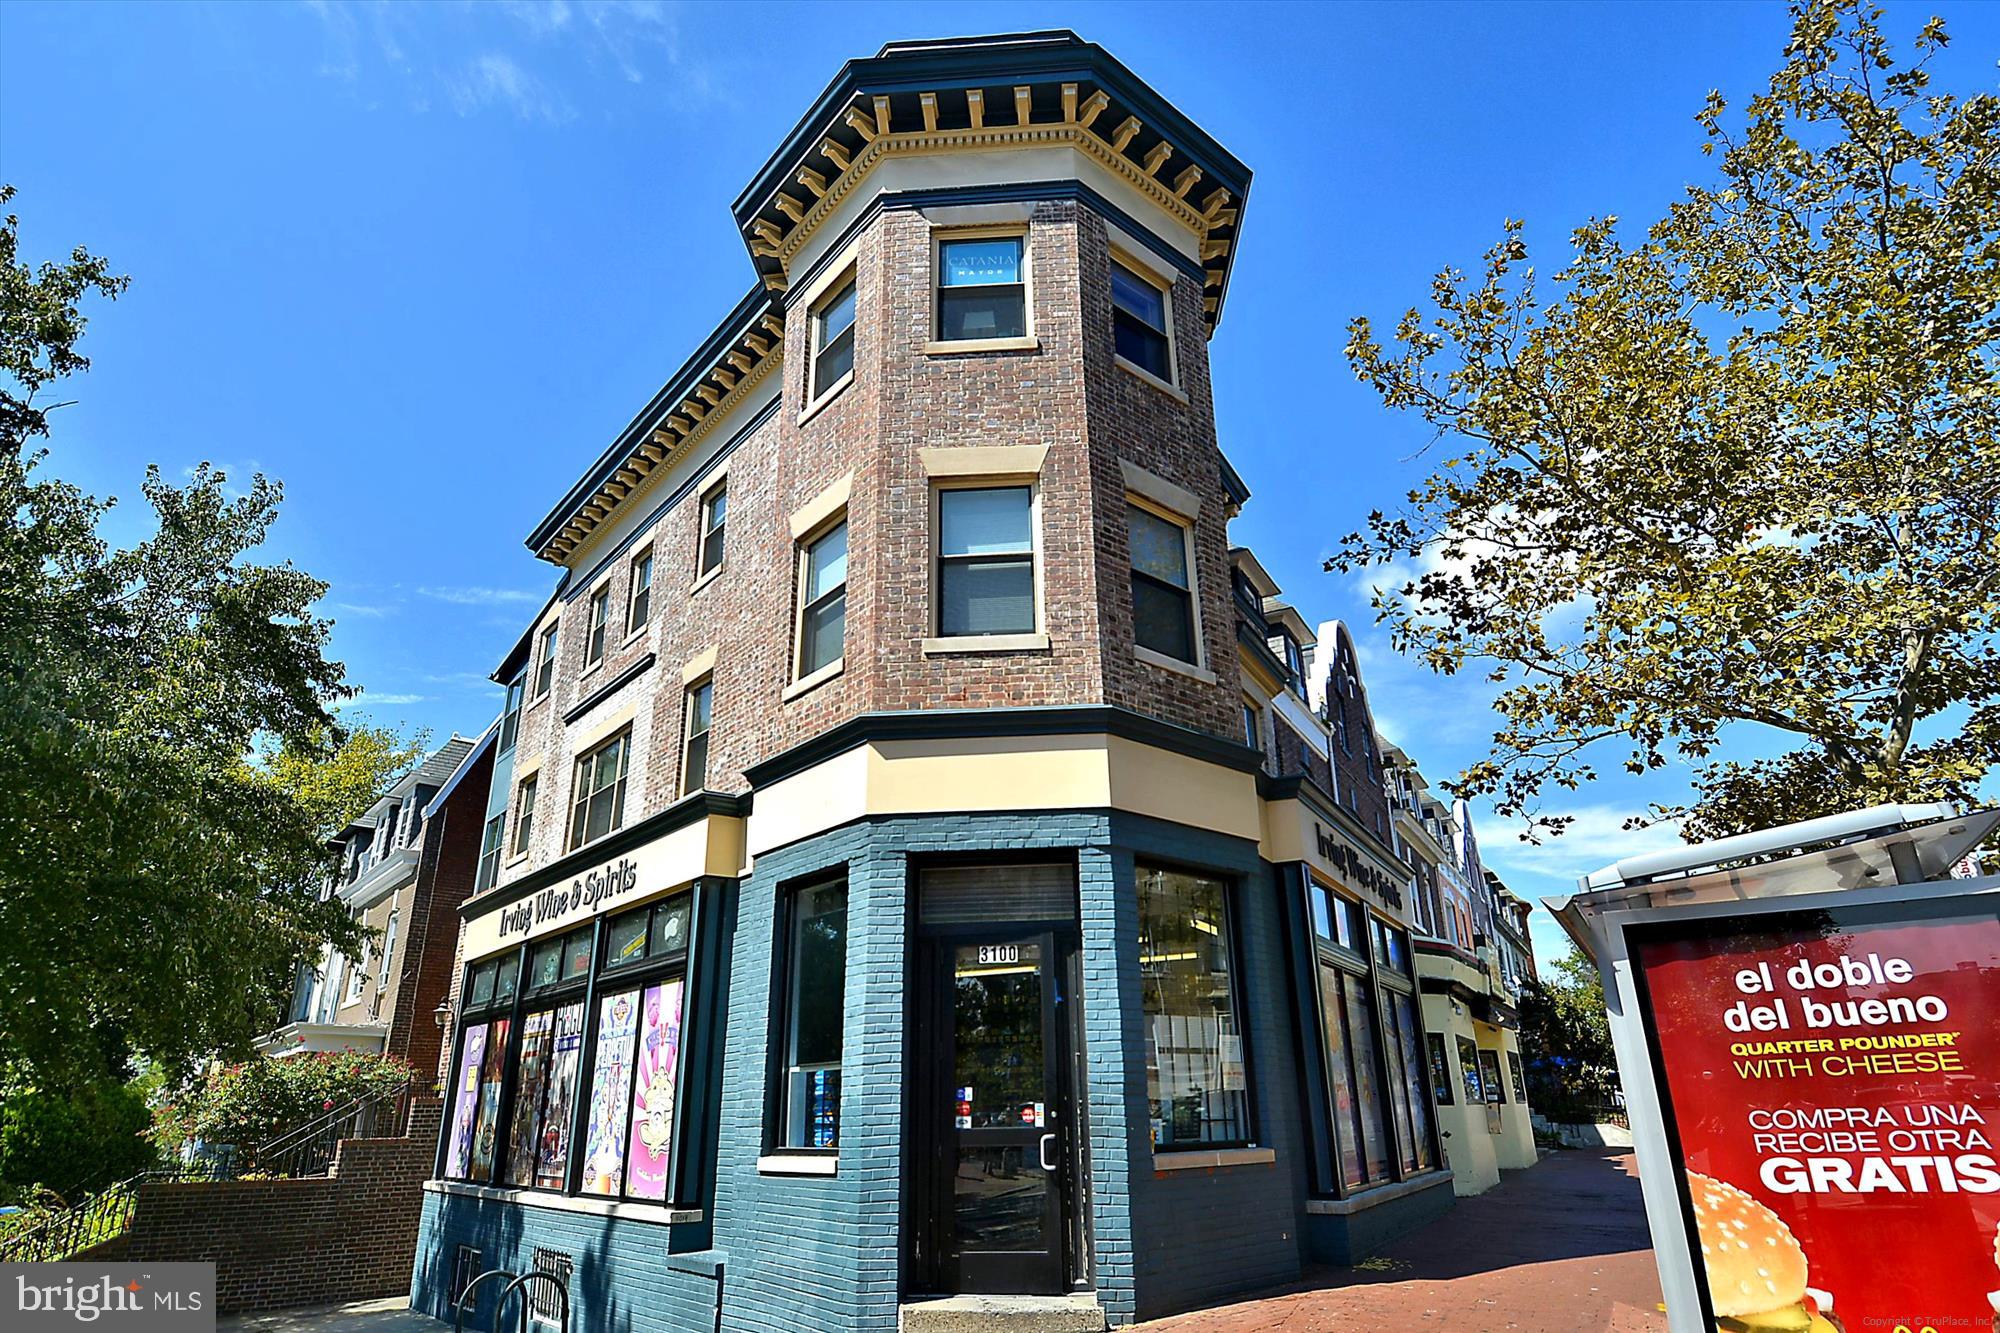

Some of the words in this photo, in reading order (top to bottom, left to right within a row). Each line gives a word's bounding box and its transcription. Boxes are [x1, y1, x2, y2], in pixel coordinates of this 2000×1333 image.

[948, 256, 1014, 266] CATANIA
[1315, 822, 1347, 881] Irving
[1345, 845, 1370, 889] Wine
[1376, 870, 1402, 911] Spirits
[499, 900, 533, 937] Irving
[535, 889, 569, 924] Wine
[570, 880, 581, 910] &
[583, 858, 637, 911] Spirits
[981, 946, 1016, 961] 3100
[1735, 962, 1775, 994] el
[1786, 953, 1914, 990] doble
[1723, 998, 1790, 1032] del
[1801, 995, 1948, 1028] bueno
[1730, 1038, 1836, 1056] QUARTER
[1733, 1058, 1814, 1079] WITH
[1821, 1051, 1964, 1076] CHEESE
[1749, 1107, 1899, 1130] COMPRA
[1904, 1104, 1986, 1126] UNA
[1753, 1131, 1882, 1154] RECIBE
[1888, 1129, 1992, 1151] OTRA
[1759, 1154, 2000, 1193] GRATIS
